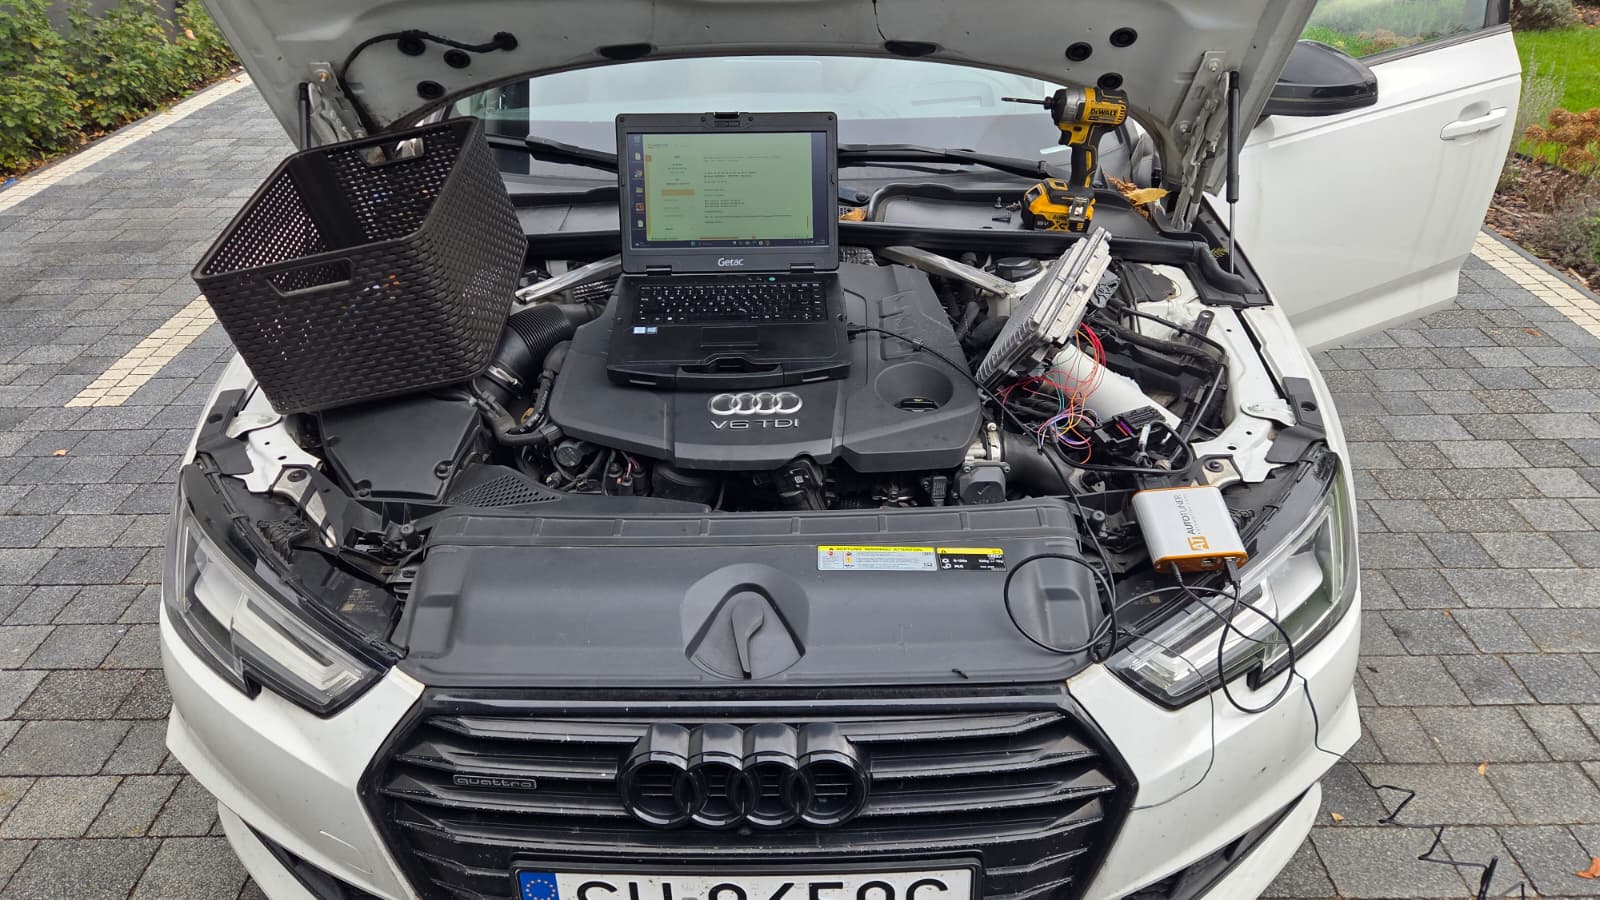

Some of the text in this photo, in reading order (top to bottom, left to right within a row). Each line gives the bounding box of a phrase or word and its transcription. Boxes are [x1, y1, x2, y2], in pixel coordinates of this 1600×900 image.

[718, 258, 744, 267] Getac
[710, 419, 799, 429] V6 TDI
[1174, 495, 1196, 535] AUTOTUNER
[457, 778, 532, 788] quattro
